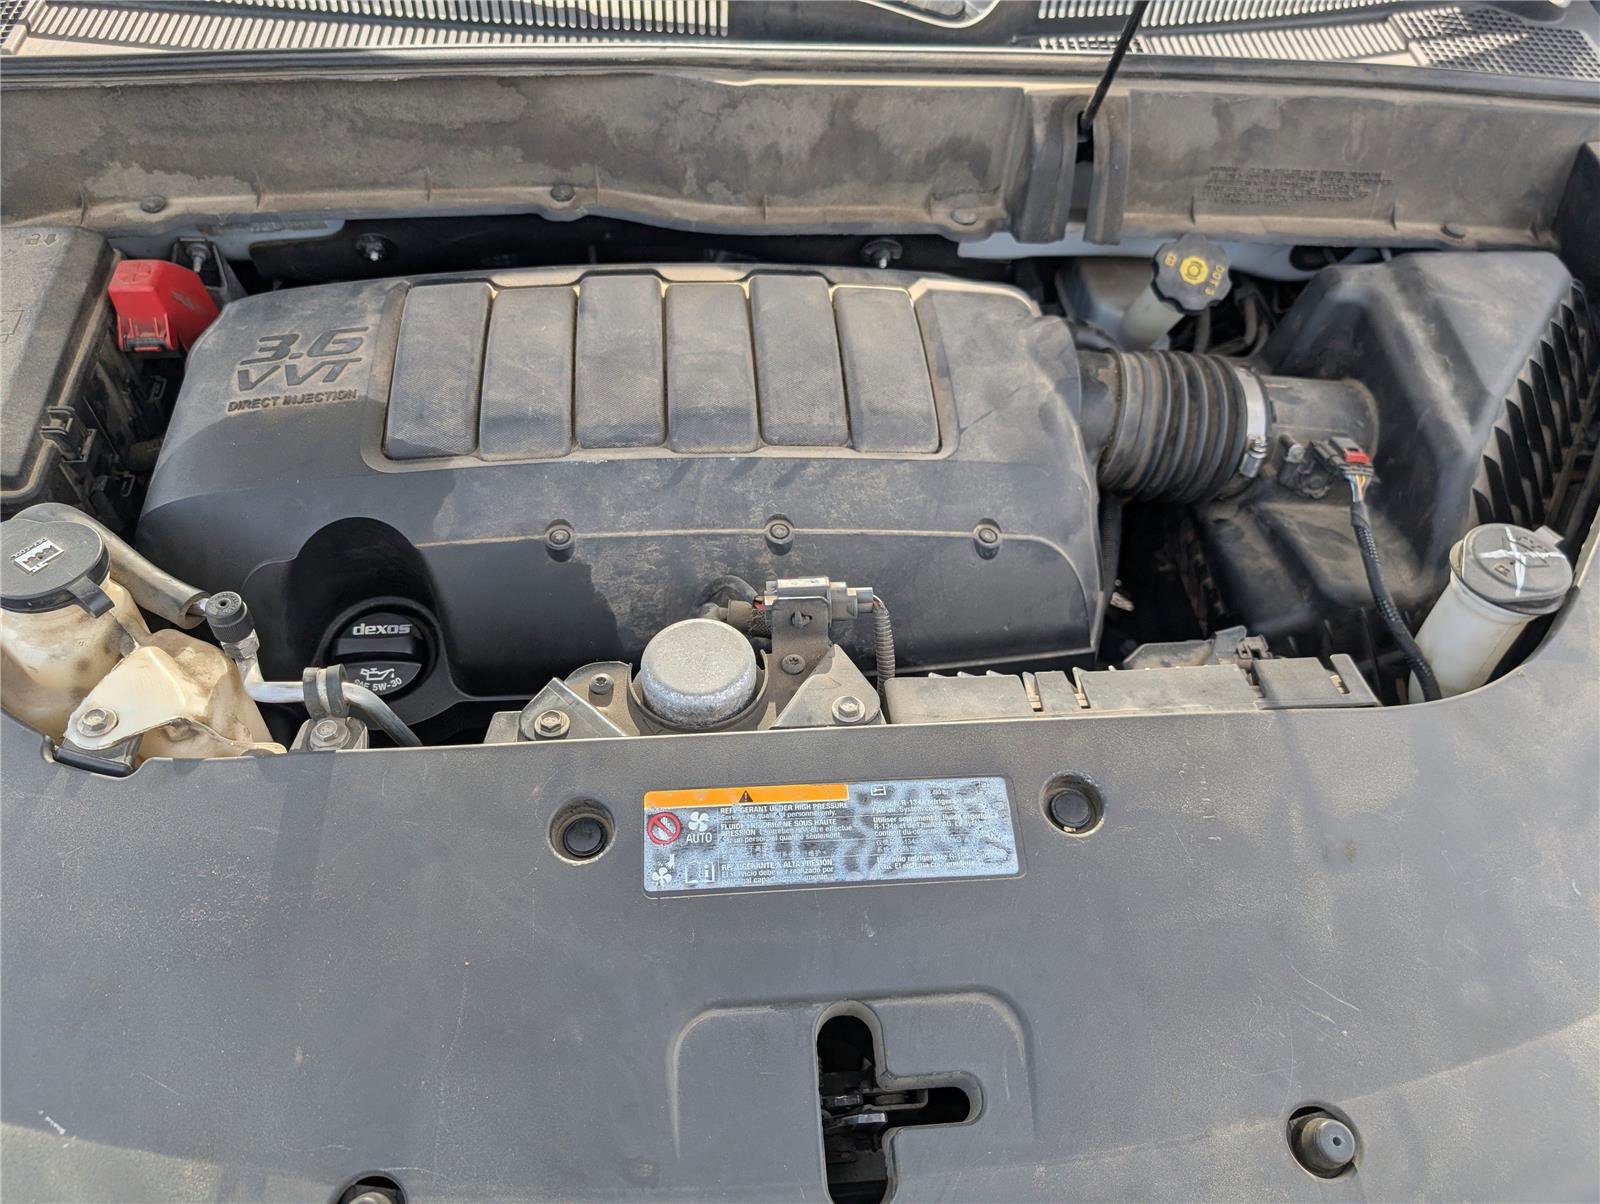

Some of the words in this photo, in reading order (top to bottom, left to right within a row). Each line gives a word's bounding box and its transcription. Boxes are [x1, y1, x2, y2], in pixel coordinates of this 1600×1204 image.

[240, 326, 369, 366] 3.6
[238, 357, 362, 392] VVT
[227, 396, 281, 412] DIRECT
[282, 389, 357, 406] INJECTION
[352, 623, 413, 636] dexos
[372, 677, 402, 692] 5W-30
[720, 805, 768, 814] REFGERANT
[769, 804, 793, 812] UDER
[794, 803, 812, 811] HIGH
[720, 822, 745, 830] FLUID
[793, 819, 813, 827] SOUS
[814, 818, 837, 826] HAUTE
[873, 815, 898, 824] Utiliser
[686, 832, 713, 843] AUTO
